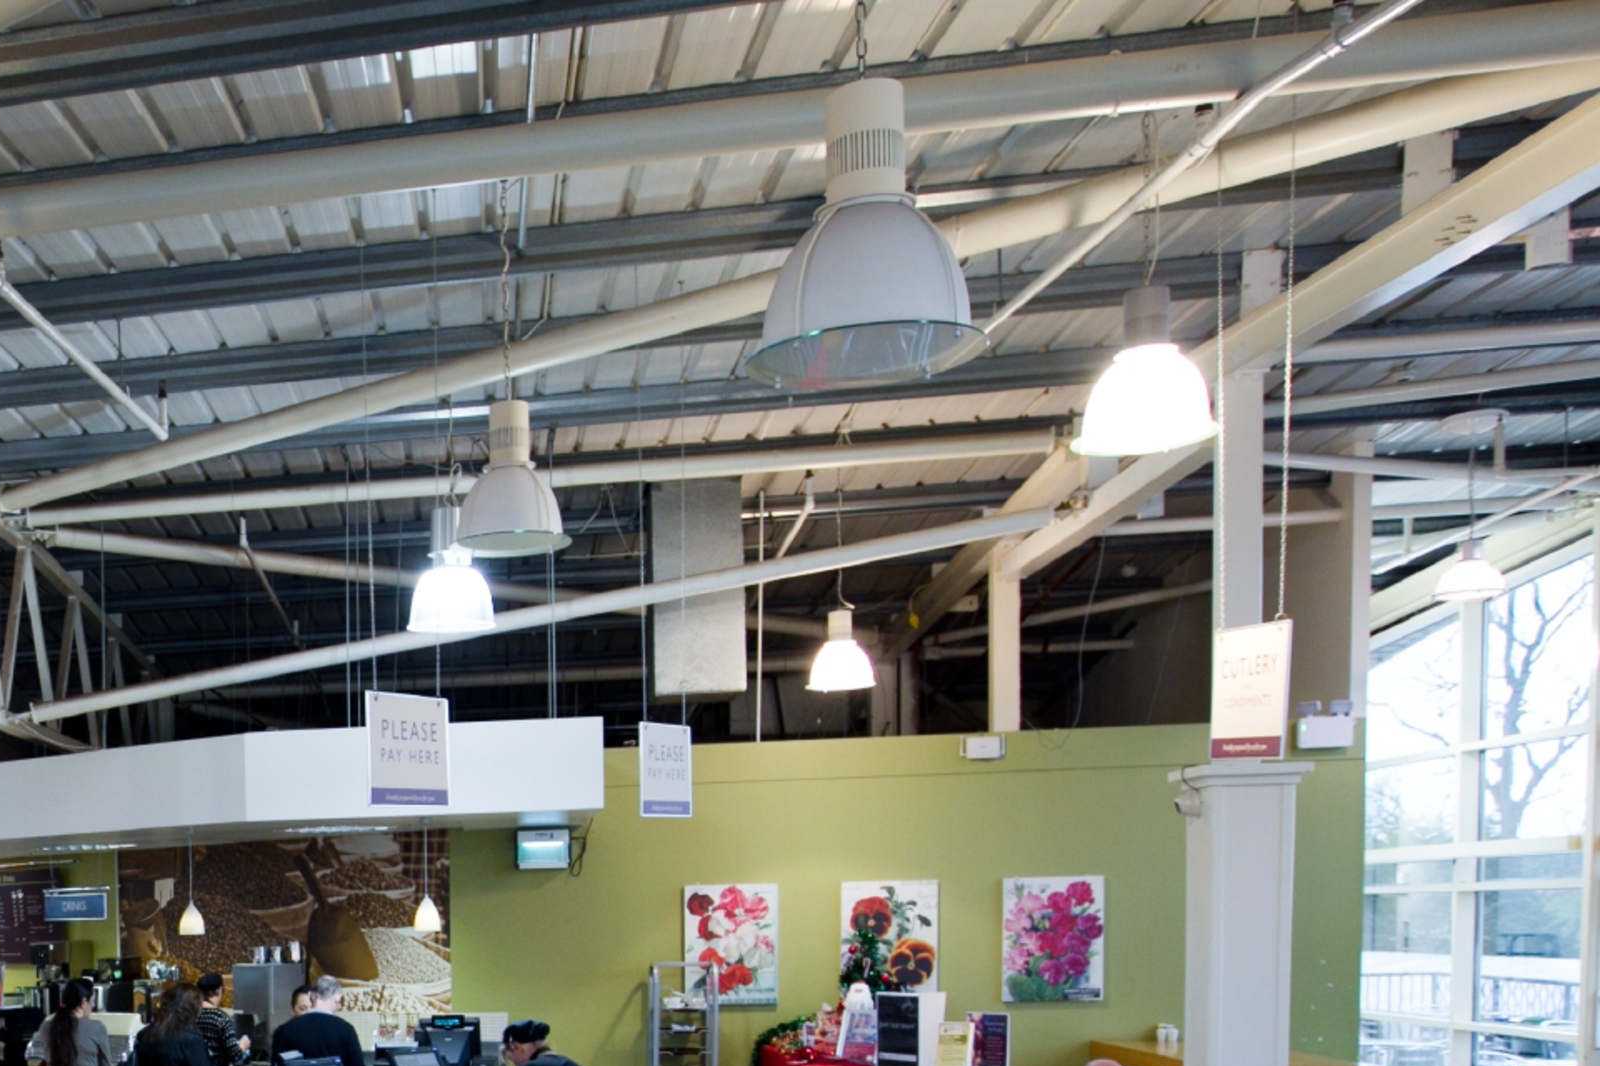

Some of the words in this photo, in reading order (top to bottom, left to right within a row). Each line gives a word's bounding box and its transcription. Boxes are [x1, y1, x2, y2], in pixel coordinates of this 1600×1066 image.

[1221, 653, 1277, 679] CUTLERY
[381, 719, 438, 742] PLEASE
[380, 748, 402, 762] PAY
[409, 749, 439, 765] HERE
[648, 744, 684, 762] PLEASE
[648, 767, 662, 780] PAY
[665, 768, 685, 781] HERE
